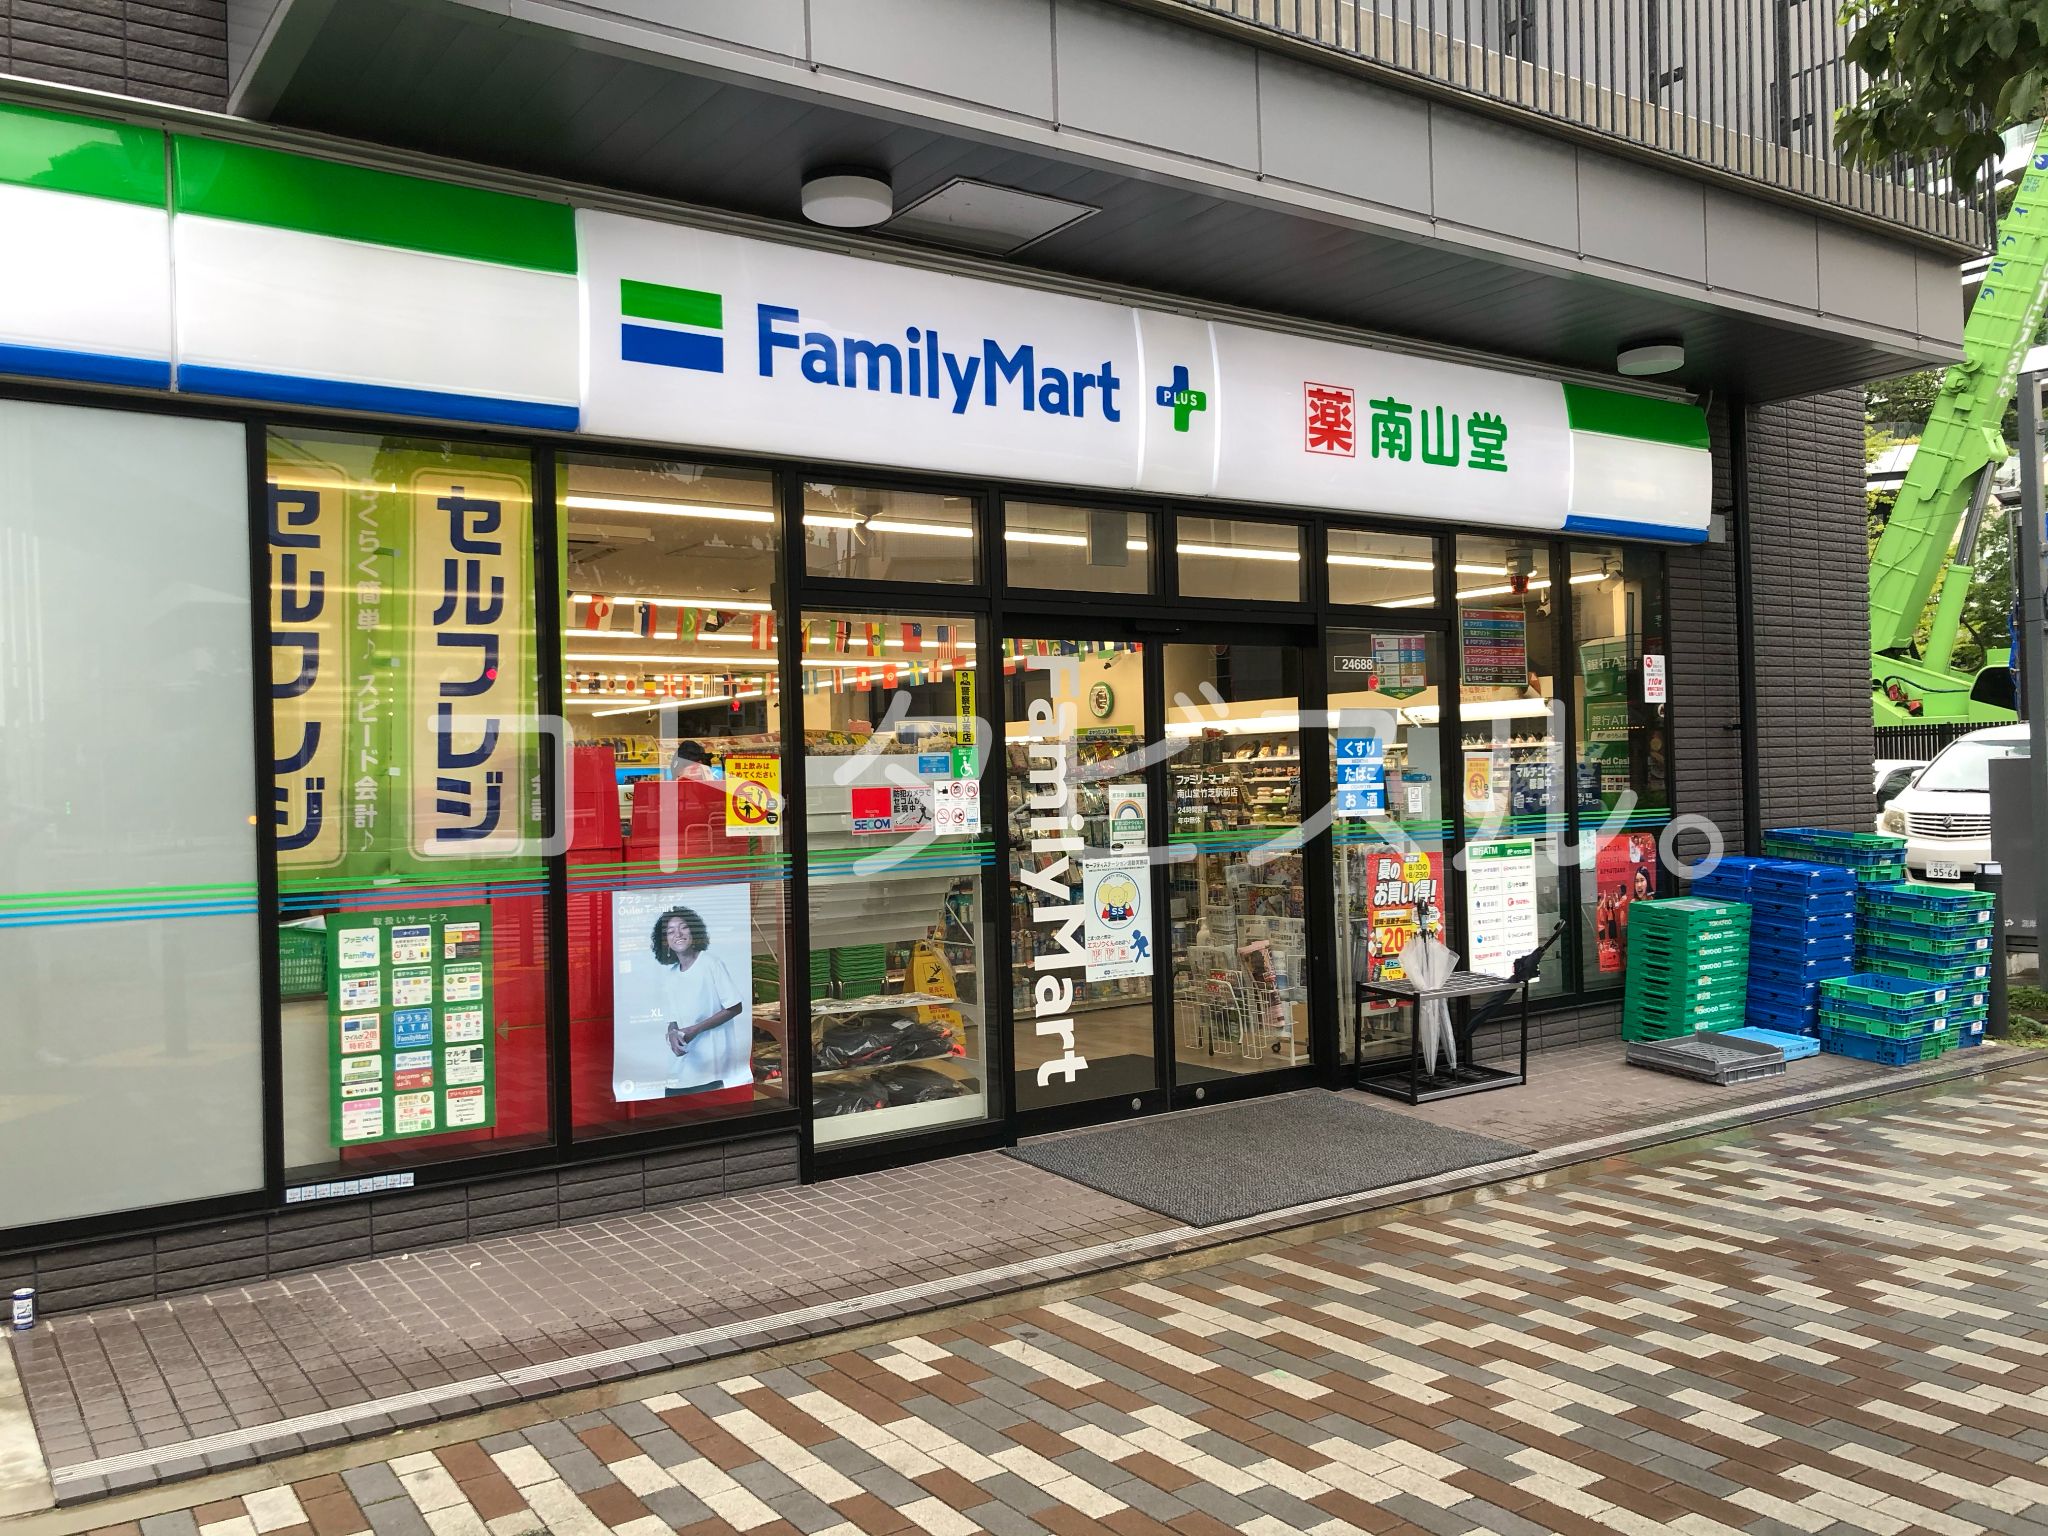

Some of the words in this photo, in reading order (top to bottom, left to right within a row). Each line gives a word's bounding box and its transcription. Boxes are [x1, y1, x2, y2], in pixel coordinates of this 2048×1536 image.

[757, 303, 1121, 423] FamilyMart
[1163, 390, 1198, 407] PLUS
[1308, 388, 1353, 452] 薬
[1369, 396, 1508, 473] 南山堂
[433, 485, 505, 843] セルフレジ
[1342, 659, 1373, 670] 24688
[1344, 741, 1376, 756] くすり
[735, 762, 770, 770] 路上飲みは
[729, 771, 777, 779] 止めてください
[1344, 766, 1377, 782] たばこ
[1515, 767, 1557, 778] マルチコピー
[1176, 774, 1230, 785] ファミリーマート
[893, 789, 932, 798] 防犯カメラで
[1176, 787, 1239, 799] 南山堂竹芝駅前店
[1345, 791, 1378, 808] お酒
[893, 805, 916, 814] 監視中
[1177, 805, 1209, 814] 24時間営業
[854, 819, 891, 830] SECOM
[1177, 816, 1202, 825] 年中無休
[1021, 655, 1089, 1087] FamilyMart
[1377, 858, 1401, 881] 夏の
[1373, 879, 1438, 907] お買い得!
[618, 904, 644, 916] Outer
[646, 903, 676, 914] T-shirt
[1111, 907, 1124, 916] SS
[373, 913, 449, 926] 取扱いサービス
[343, 935, 375, 944] ファミペイ
[343, 952, 376, 960] FamiPay
[396, 1014, 429, 1022] ゆうちょ
[650, 1008, 664, 1018] XL
[396, 1033, 430, 1042] FamilyMart
[446, 1049, 468, 1058] マルチ
[446, 1058, 468, 1066] コピー
